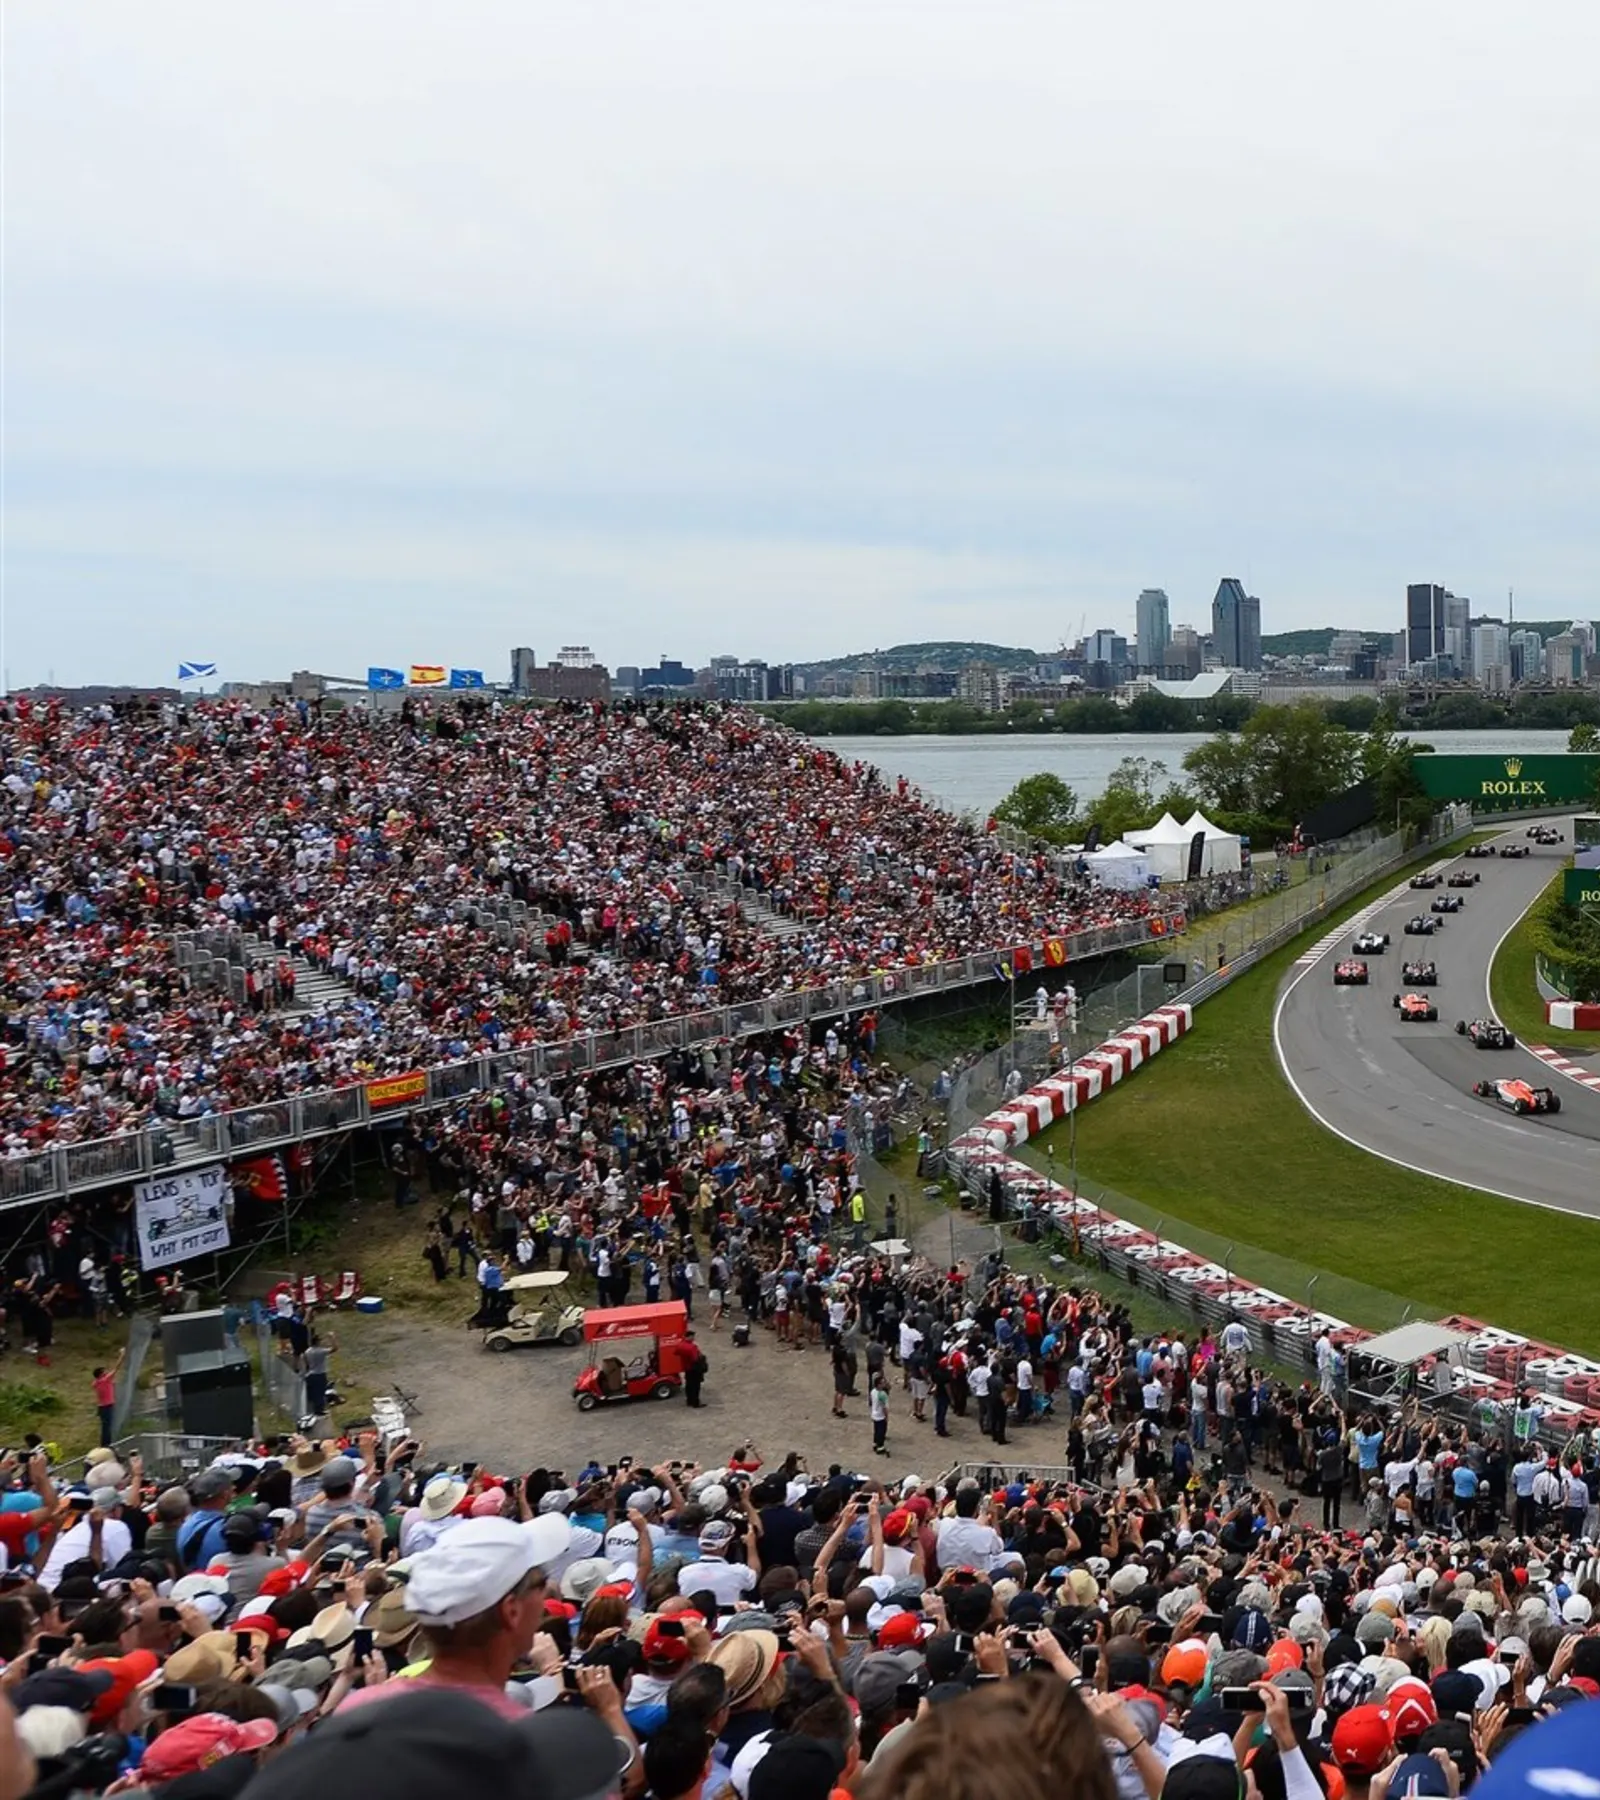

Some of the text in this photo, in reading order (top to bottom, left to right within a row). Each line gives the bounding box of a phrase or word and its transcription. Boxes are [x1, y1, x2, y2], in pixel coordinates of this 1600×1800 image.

[1481, 781, 1546, 795] ROLEX
[198, 1170, 220, 1188] TOP
[151, 1240, 178, 1258] WHY
[181, 1234, 199, 1251] PIT
